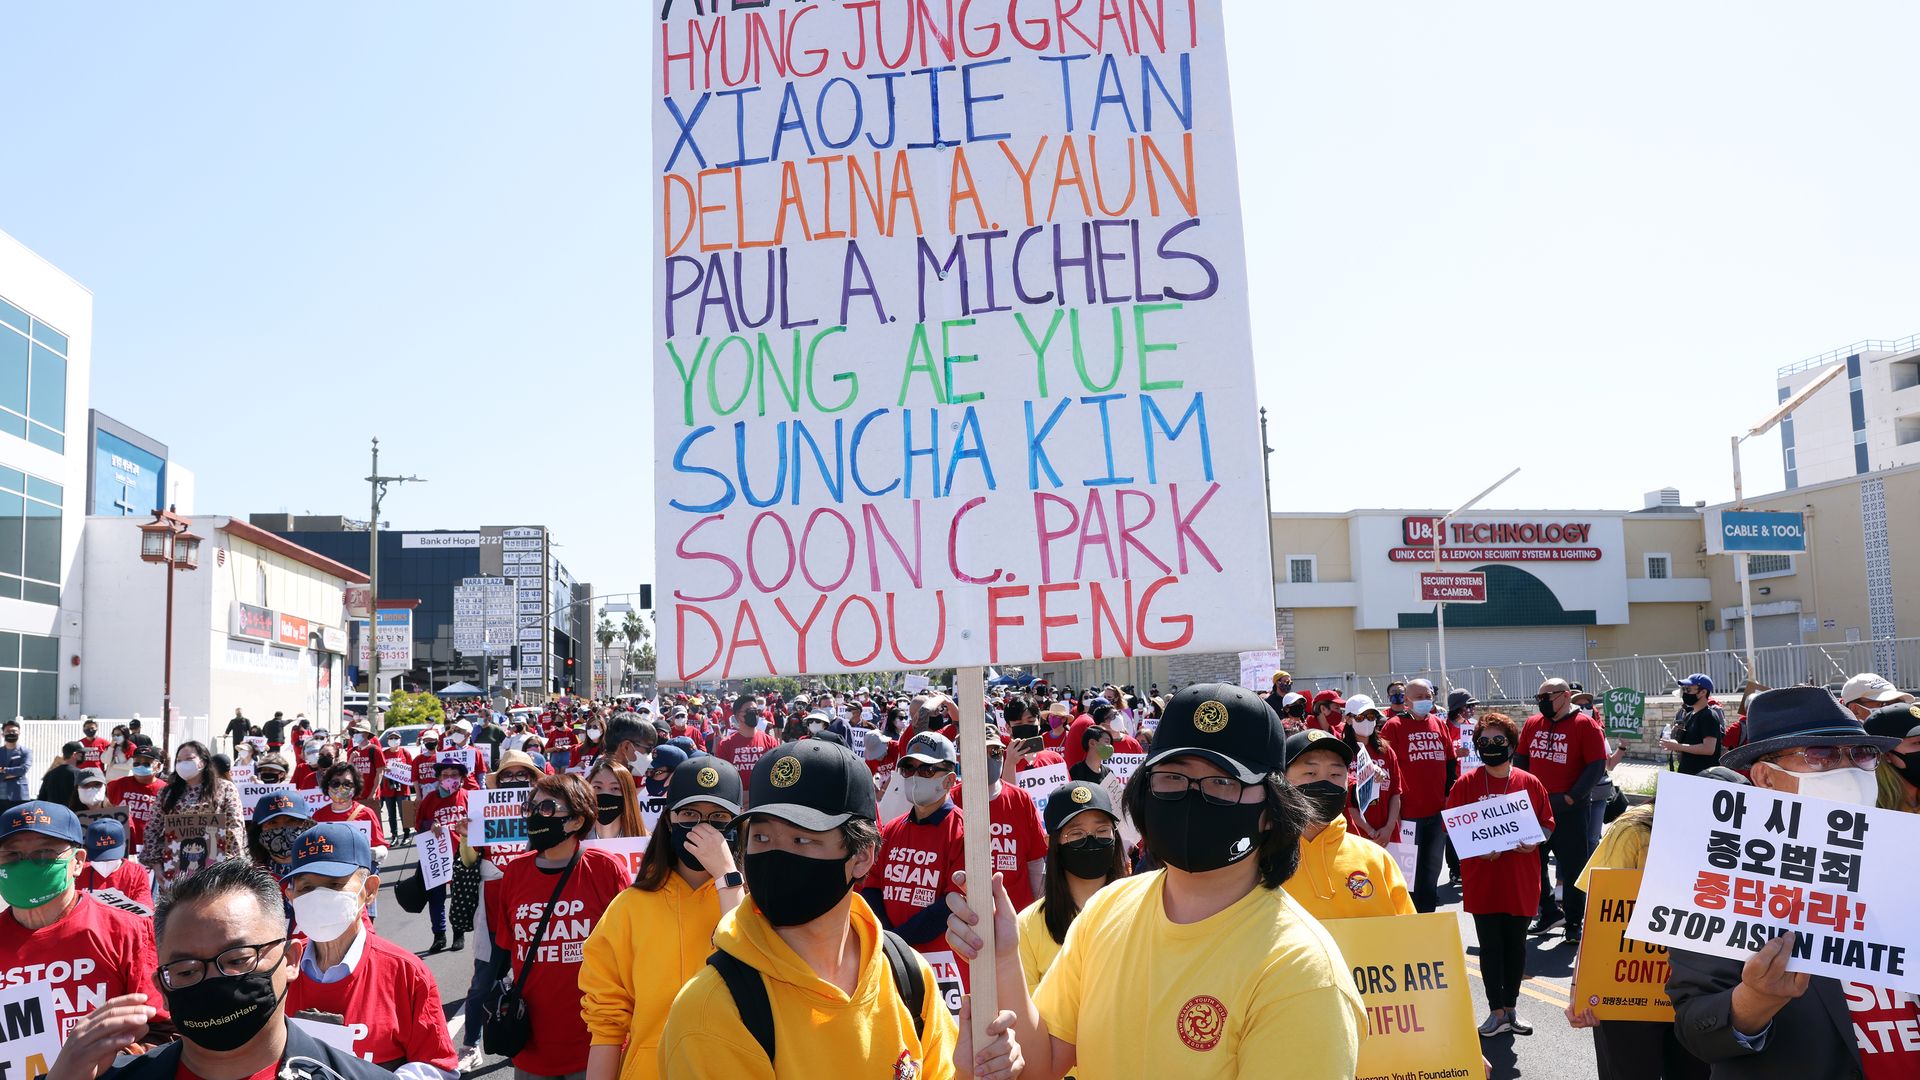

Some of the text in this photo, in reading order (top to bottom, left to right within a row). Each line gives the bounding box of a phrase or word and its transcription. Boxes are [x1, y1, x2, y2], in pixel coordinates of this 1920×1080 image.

[662, 4, 830, 95] HYUNG
[843, 0, 1001, 71] JUNG
[663, 52, 1194, 172] XIAOJIE TAN
[663, 133, 1200, 258] DELAINA A. YAUN
[664, 218, 1220, 339] PAUL A. MICHELS
[664, 303, 1186, 426] YONG AE YUE
[669, 391, 1216, 515] SUNCHA KIM
[479, 535, 502, 545] 2727
[1450, 523, 1592, 544] TECHNOLOGY
[1724, 524, 1802, 538] CABLE & TOOL
[420, 537, 476, 547] Bank of Hope
[673, 482, 1223, 603] SOON C. PARK
[1395, 550, 1598, 560] UNIX CCT & LEDVON SECURITY SYSTEM & LIGHTING
[463, 578, 482, 586] NARA
[1423, 577, 1483, 586] SECURITY SYSTEMS
[1433, 588, 1474, 597] & CAMERA
[675, 576, 1195, 682] DAYOU FENG
[1609, 690, 1641, 705] scrub
[1609, 712, 1641, 729] hate
[1408, 732, 1440, 741] #STOP
[1408, 741, 1444, 752] ASIAN
[1408, 751, 1435, 762] HATE
[1018, 773, 1066, 789] #Do the
[488, 791, 515, 804] KEEP
[483, 804, 521, 818] GRAND
[1447, 799, 1529, 828] STOP KILLING
[168, 815, 219, 828] HATE IS A
[484, 818, 529, 840] SAFE
[1471, 821, 1520, 842] ASIANS
[179, 826, 207, 838] VIRUS
[1402, 829, 1414, 837] the
[298, 844, 335, 859] 노인회
[424, 838, 441, 879] RACISM
[490, 843, 527, 855] ASIA
[888, 846, 938, 866] #STOP
[440, 855, 449, 877] ALL
[1706, 829, 1863, 893] 증오범죄
[884, 863, 941, 888] ASIAN
[913, 893, 935, 904] RALLY
[915, 888, 936, 898] UNITY
[1693, 870, 1867, 933] 중단하라!
[515, 900, 584, 920] #SOP
[1648, 905, 1726, 944] STOP
[1820, 935, 1906, 977] HATE
[517, 944, 559, 964] HTE
[1353, 961, 1449, 995] ORS ARE
[1601, 996, 1648, 1007] 화랑청소년재단
[0, 996, 45, 1043] M
[183, 1003, 258, 1029] #StopAsianHate
[1365, 1003, 1425, 1036] TIFUL
[1391, 1068, 1469, 1080] Youth Foundation
